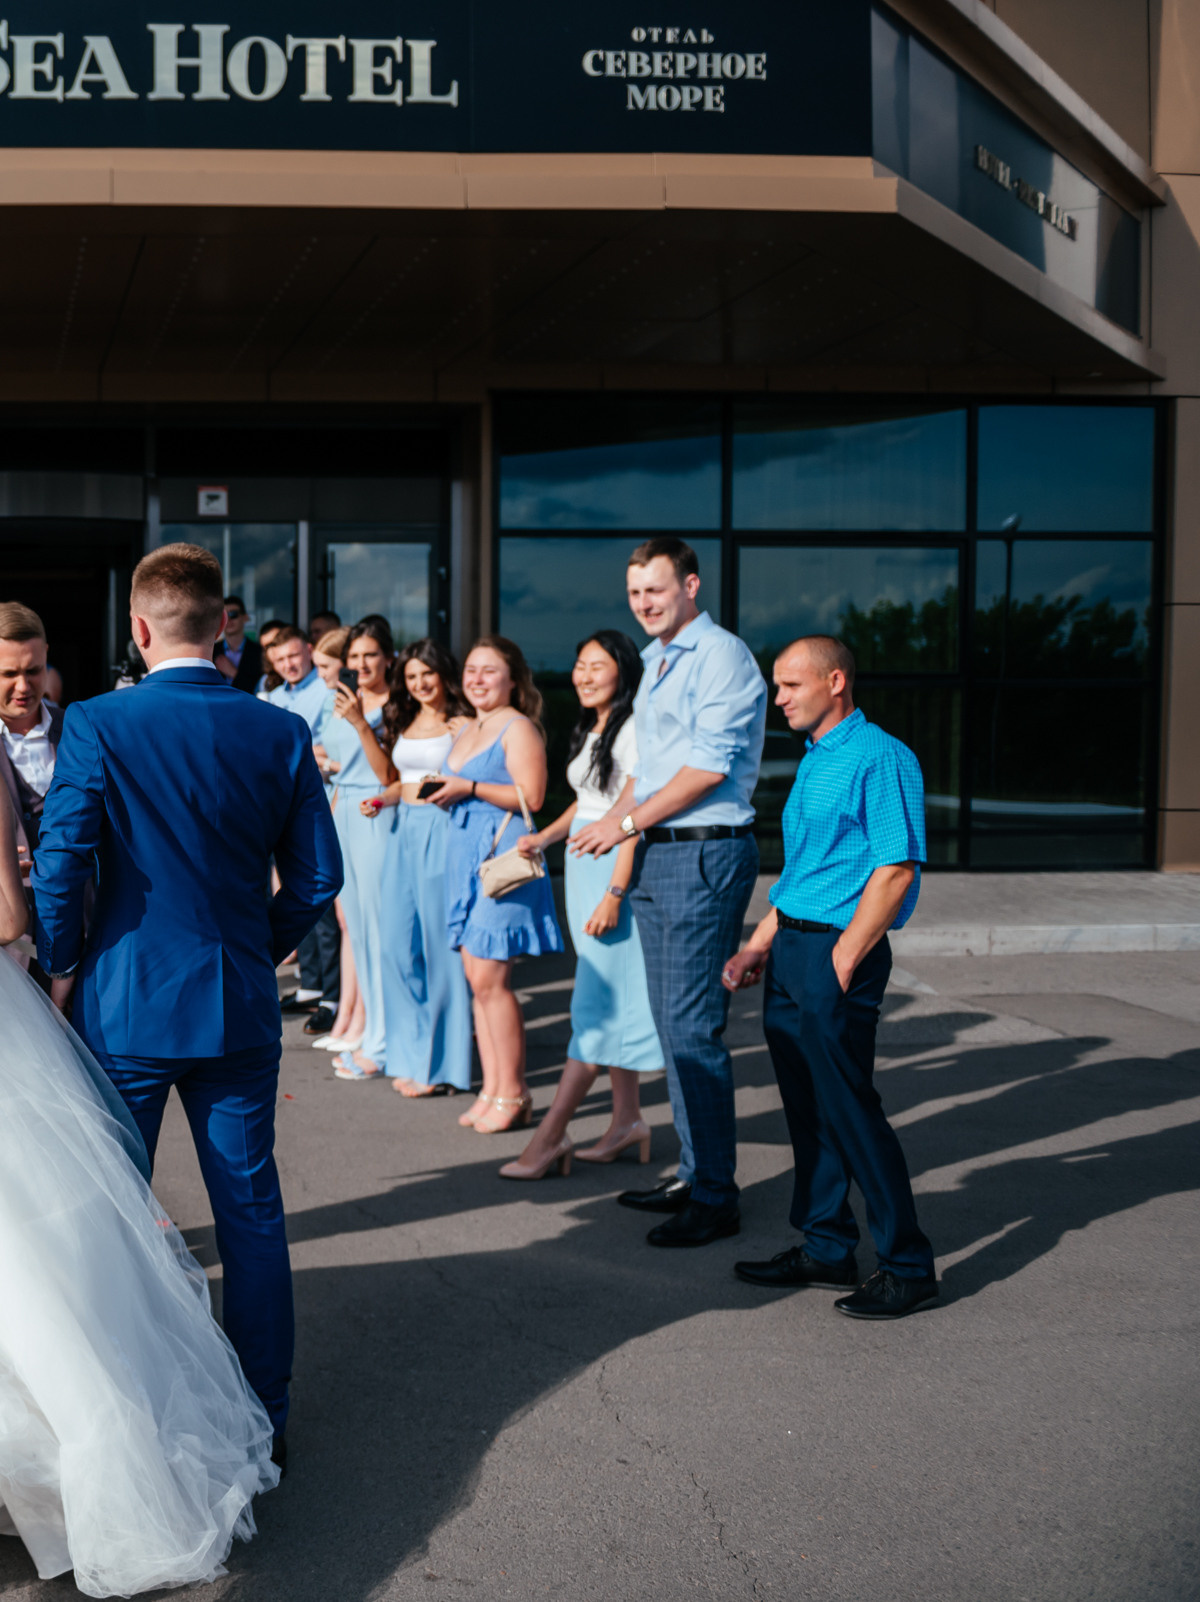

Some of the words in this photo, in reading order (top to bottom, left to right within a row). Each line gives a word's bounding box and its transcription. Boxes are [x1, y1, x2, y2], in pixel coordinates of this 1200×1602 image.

[630, 26, 715, 44] ОТЕЛЬ
[146, 23, 460, 107] HOTEL
[581, 49, 767, 81] СЕВЕРНОЕ
[626, 84, 725, 113] МОРЕ
